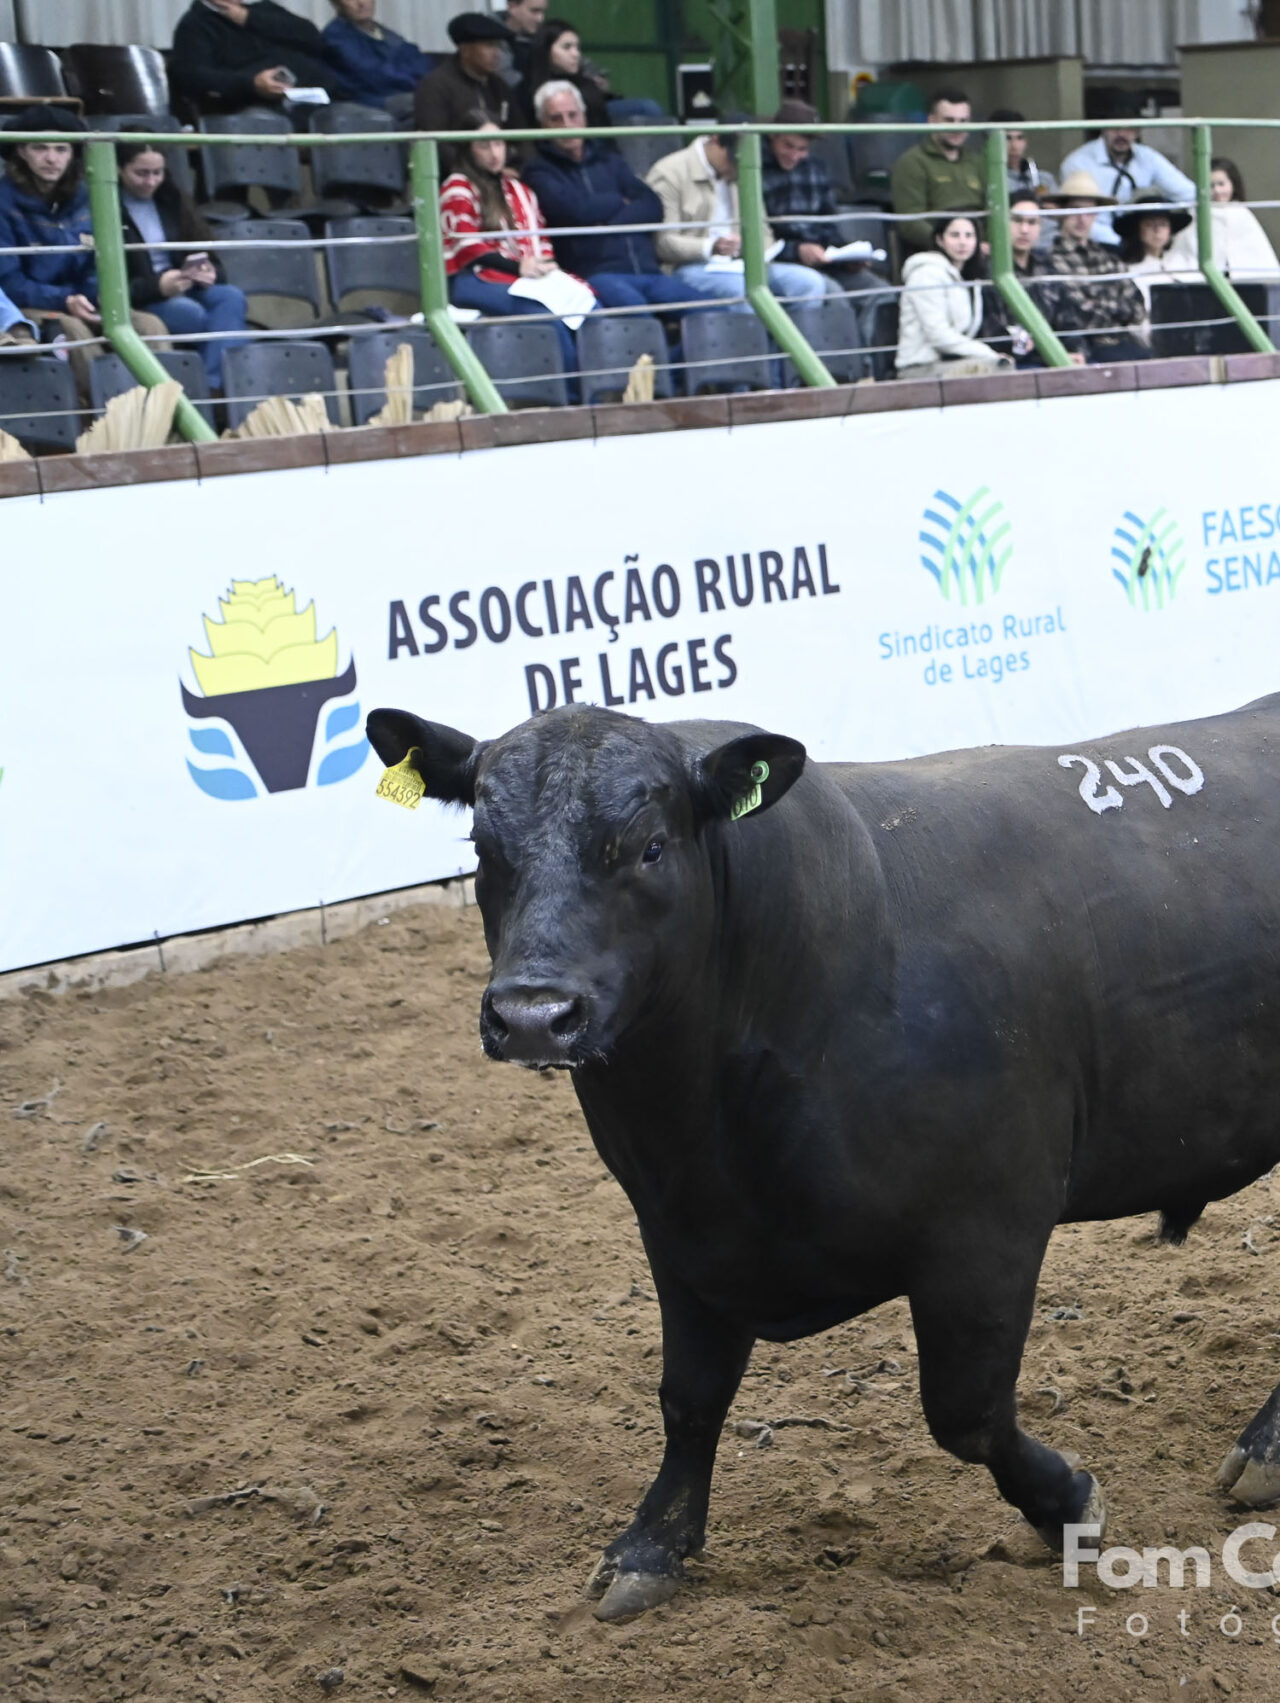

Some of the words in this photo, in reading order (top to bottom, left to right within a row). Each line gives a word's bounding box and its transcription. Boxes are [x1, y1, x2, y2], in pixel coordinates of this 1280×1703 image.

[387, 553, 682, 660] ASSOCIAÇÃO
[694, 543, 840, 613] RURAL
[878, 622, 993, 660] Sindicato
[1003, 605, 1066, 640] Rural
[524, 657, 583, 717] DE
[598, 634, 738, 707] LAGES
[924, 658, 953, 686] de
[963, 650, 1031, 684] Lages
[376, 778, 421, 809] 554392
[1057, 744, 1205, 815] 240
